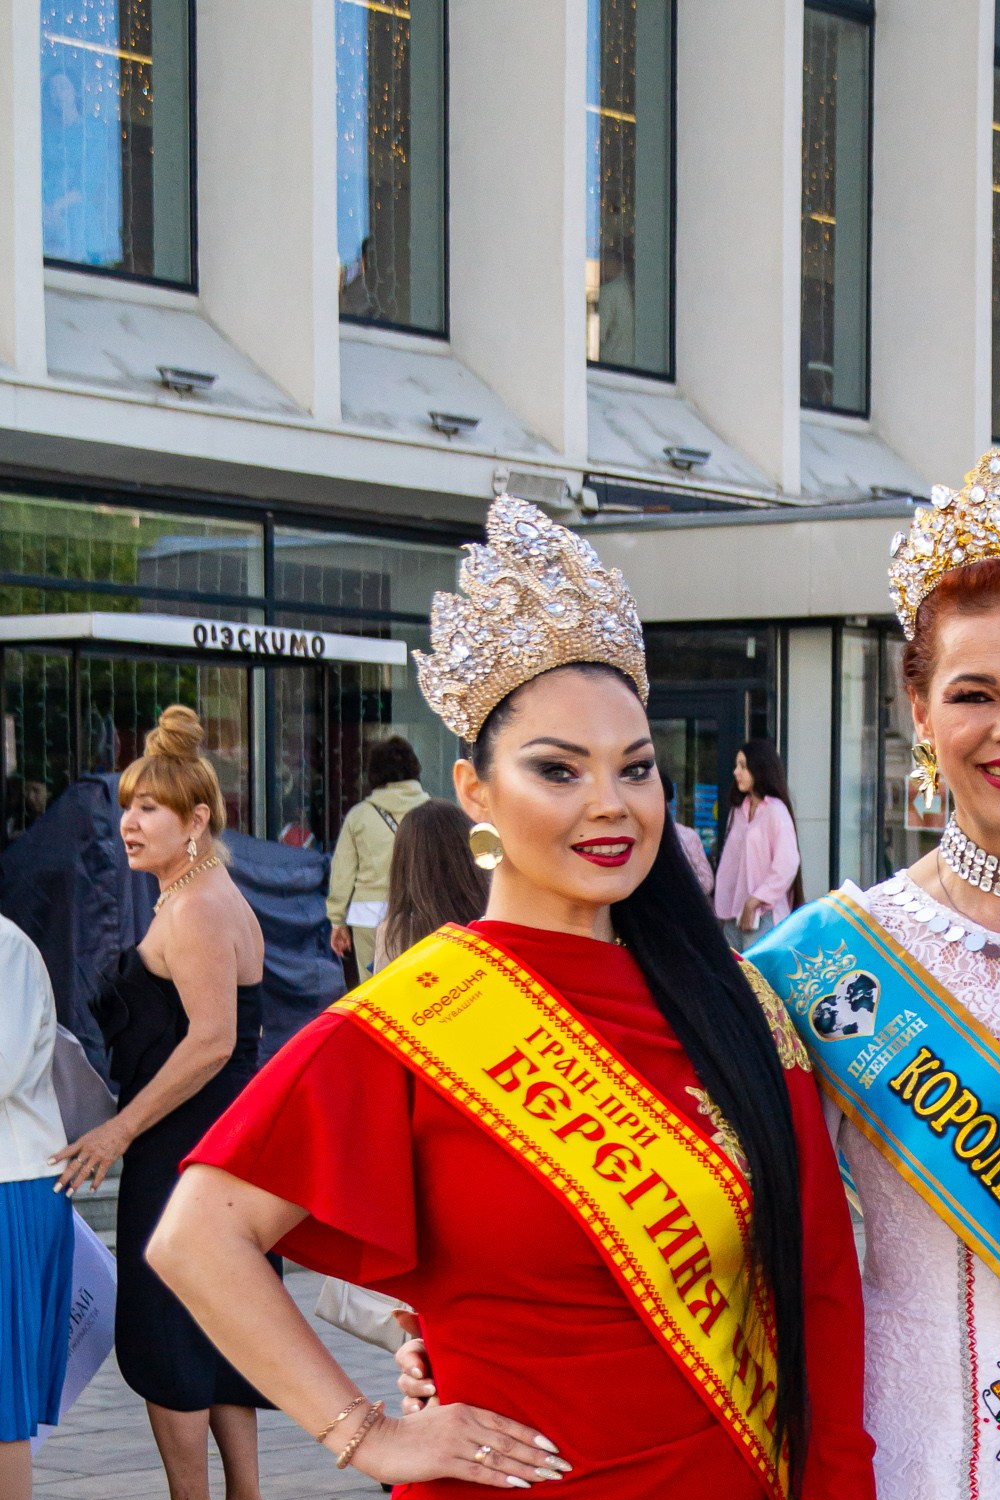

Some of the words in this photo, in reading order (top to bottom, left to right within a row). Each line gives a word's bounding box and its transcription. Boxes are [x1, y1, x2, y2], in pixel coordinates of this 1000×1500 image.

[411, 968, 488, 1027] берегиня
[847, 1009, 918, 1079] ПЛАНЕТА
[858, 1016, 929, 1090] ЖЕНЩИН
[523, 1025, 660, 1151] ГРАН-ПРИ
[481, 1045, 730, 1338] БЕРЕГИНЯ
